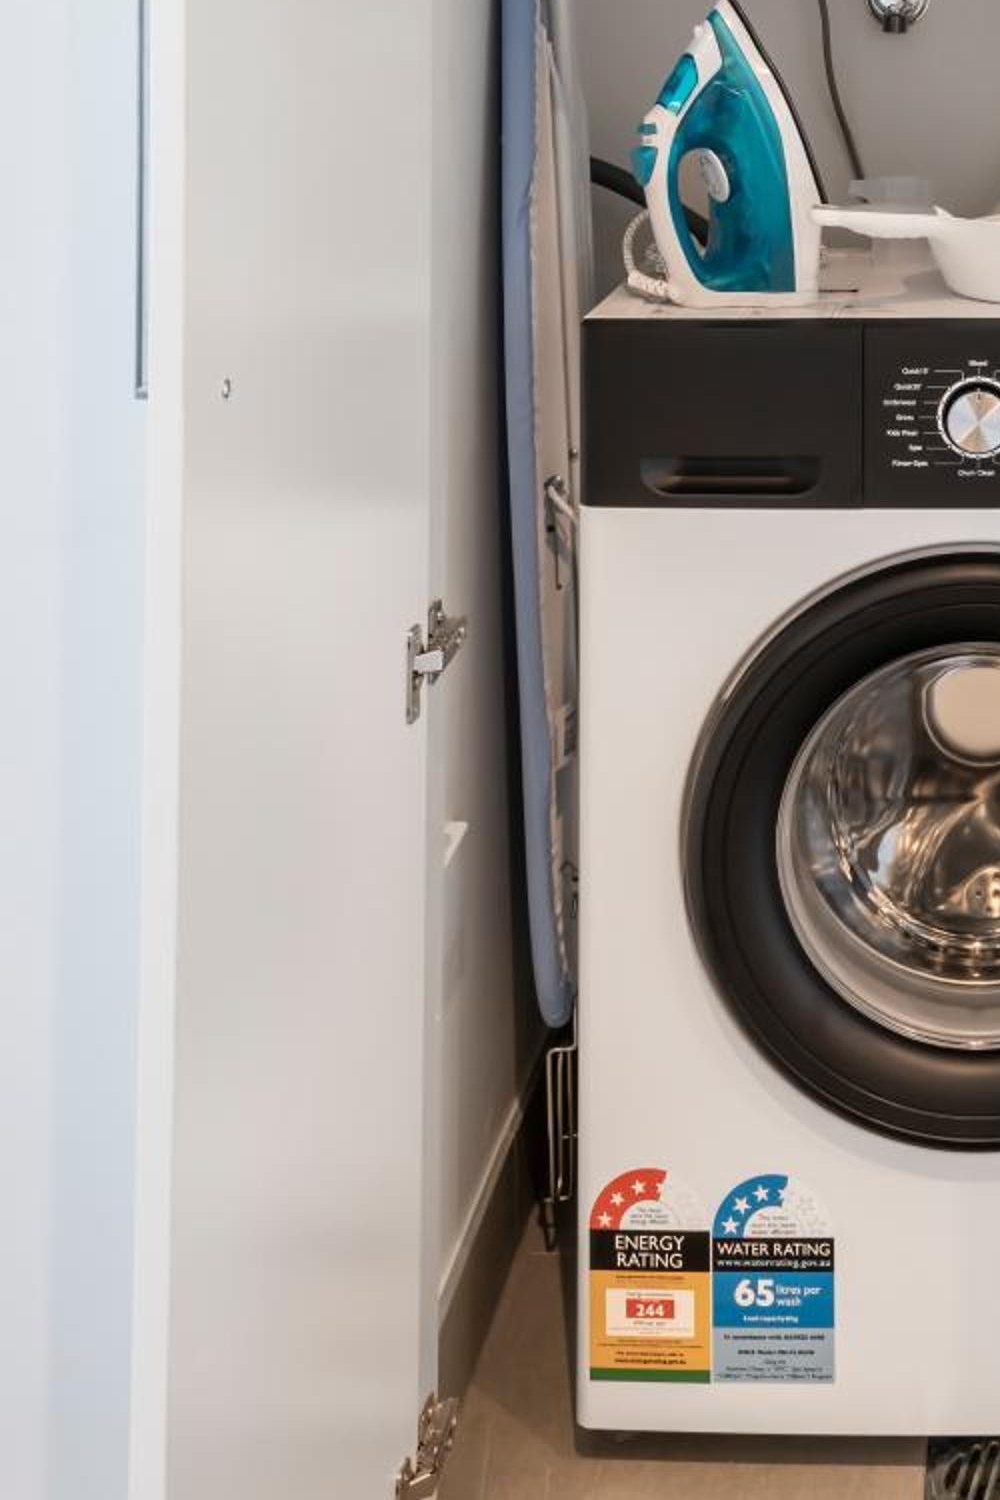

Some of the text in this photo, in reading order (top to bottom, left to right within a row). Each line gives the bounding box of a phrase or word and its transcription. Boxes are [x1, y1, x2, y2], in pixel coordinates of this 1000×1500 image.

[615, 1235, 685, 1251] ENERGY
[717, 1243, 831, 1257] WATER RATING
[616, 1252, 683, 1268] RATING
[717, 1259, 831, 1269] www.waterrating.gov.au
[734, 1279, 775, 1307] 65
[803, 1286, 823, 1297] per
[776, 1297, 802, 1307] wash
[635, 1303, 665, 1317] 244
